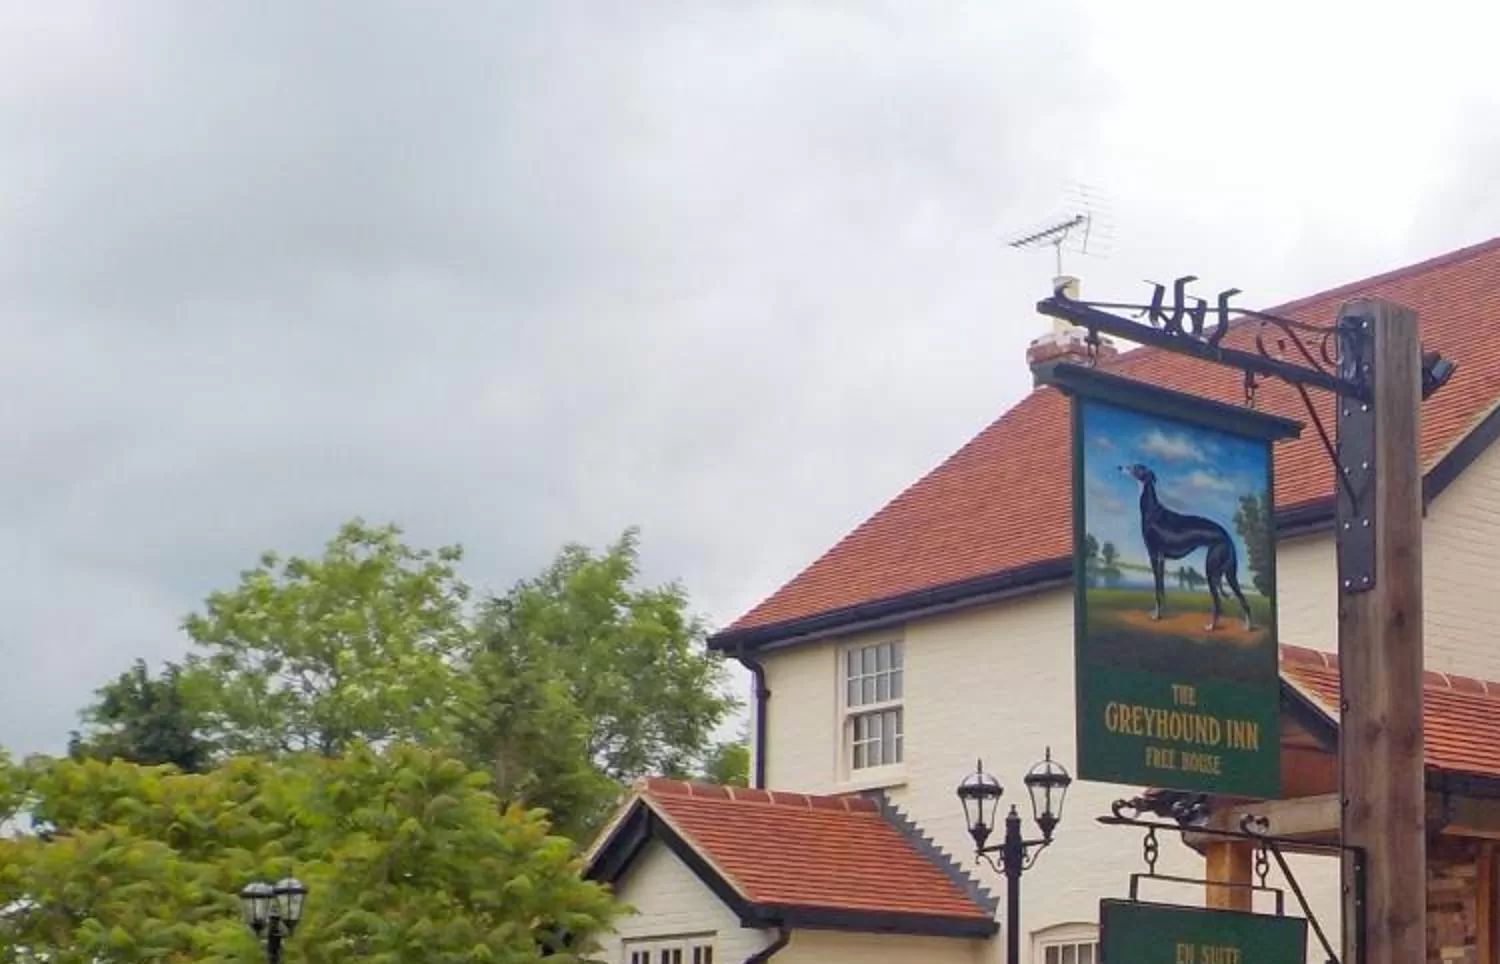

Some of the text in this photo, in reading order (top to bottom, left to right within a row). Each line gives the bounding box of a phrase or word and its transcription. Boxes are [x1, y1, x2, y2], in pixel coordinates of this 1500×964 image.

[1172, 684, 1196, 706] THE
[1104, 702, 1259, 751] GREYHOUND INN
[1146, 747, 1223, 774] FREE HOUSE
